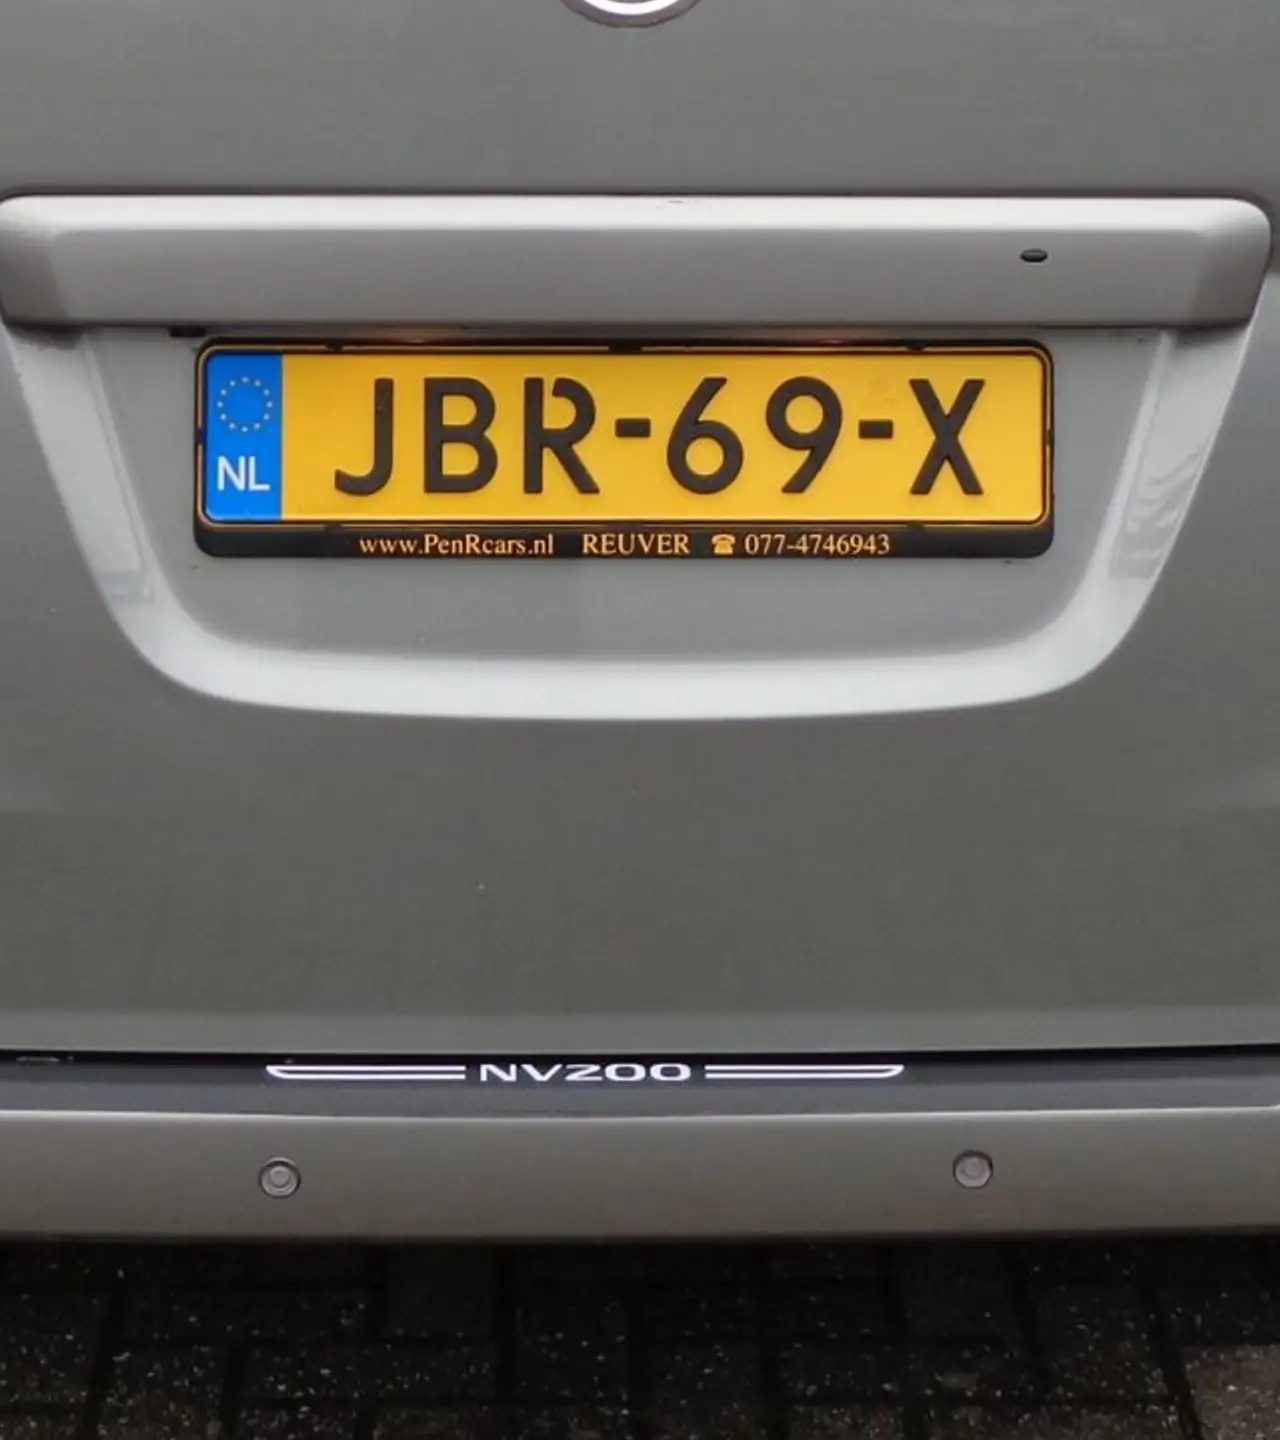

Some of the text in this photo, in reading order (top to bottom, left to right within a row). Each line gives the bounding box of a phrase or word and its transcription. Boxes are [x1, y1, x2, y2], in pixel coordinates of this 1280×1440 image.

[334, 376, 986, 497] JBR-69-X
[217, 456, 270, 492] NL
[359, 533, 891, 555] www.PenRcars.nl REUVER 077-4746943
[479, 1063, 691, 1082] NV200
